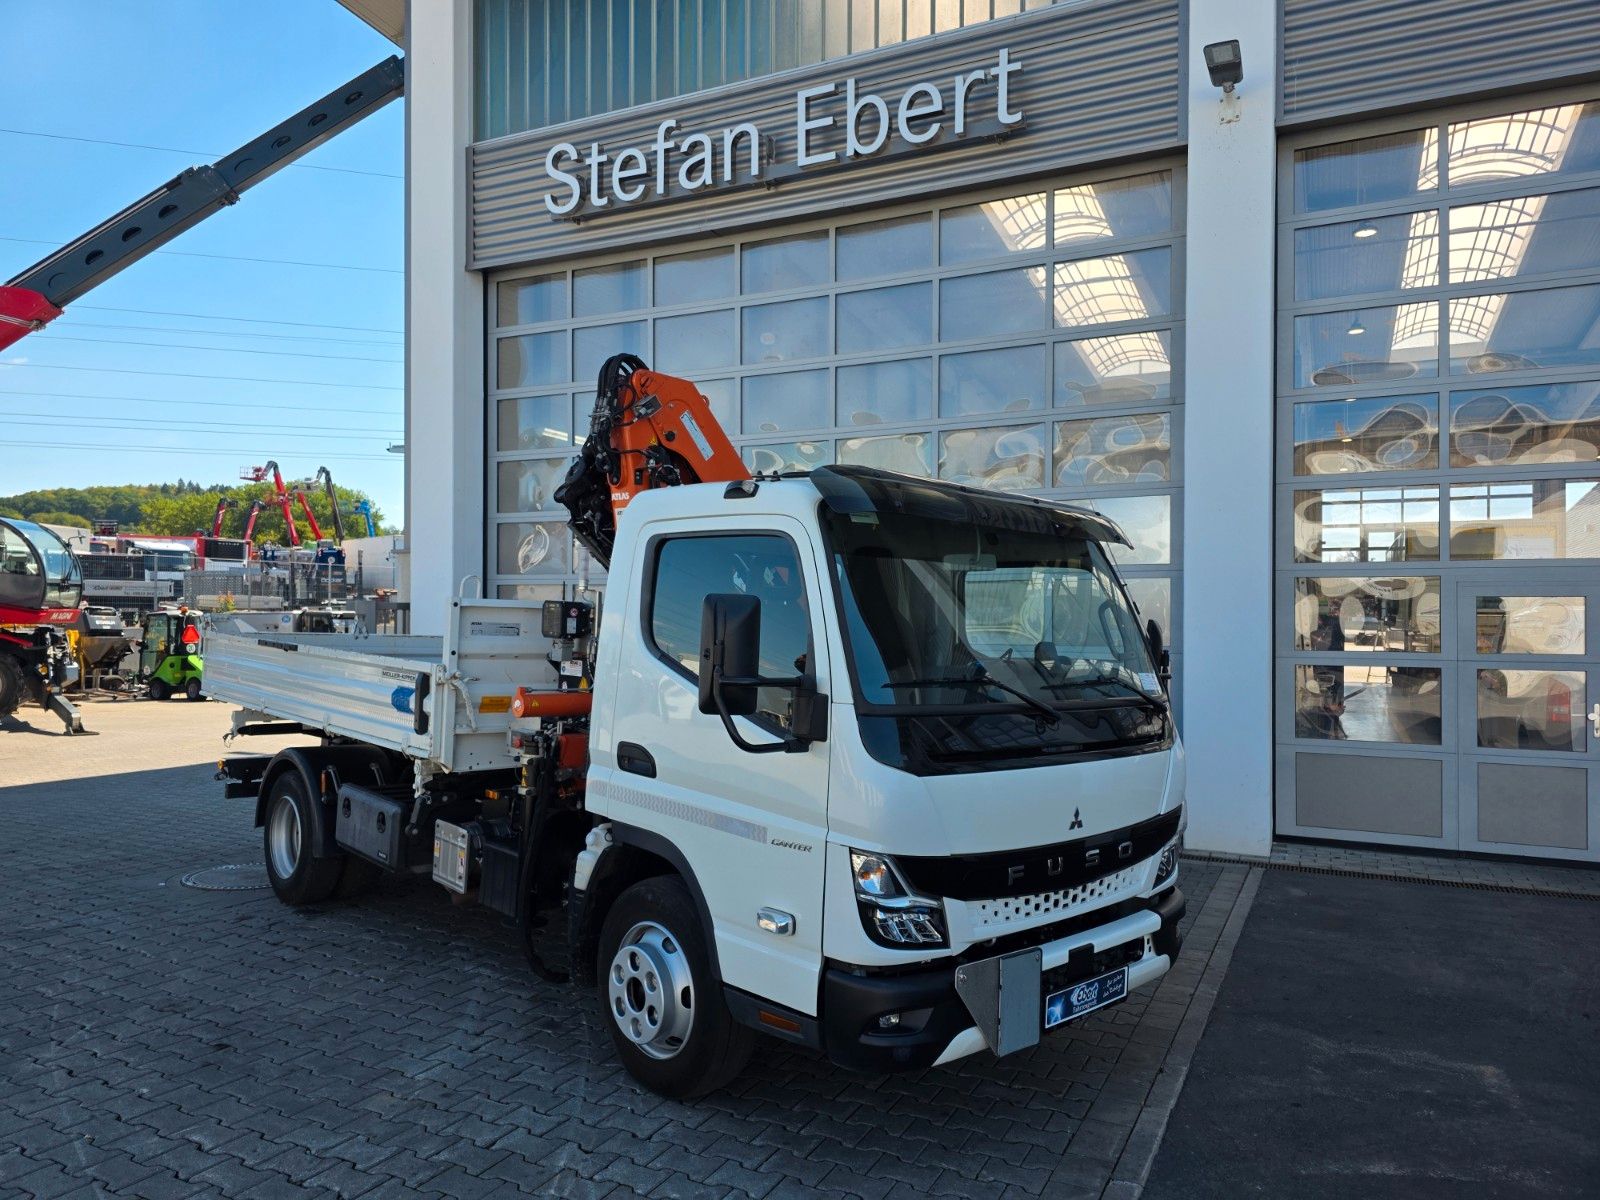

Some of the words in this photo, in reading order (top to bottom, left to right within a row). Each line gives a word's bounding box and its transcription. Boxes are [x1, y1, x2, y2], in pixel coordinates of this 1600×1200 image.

[544, 119, 762, 217] Stefan
[796, 47, 1024, 169] Ebert
[612, 492, 630, 501] ATLAS
[1008, 840, 1133, 886] FUSO
